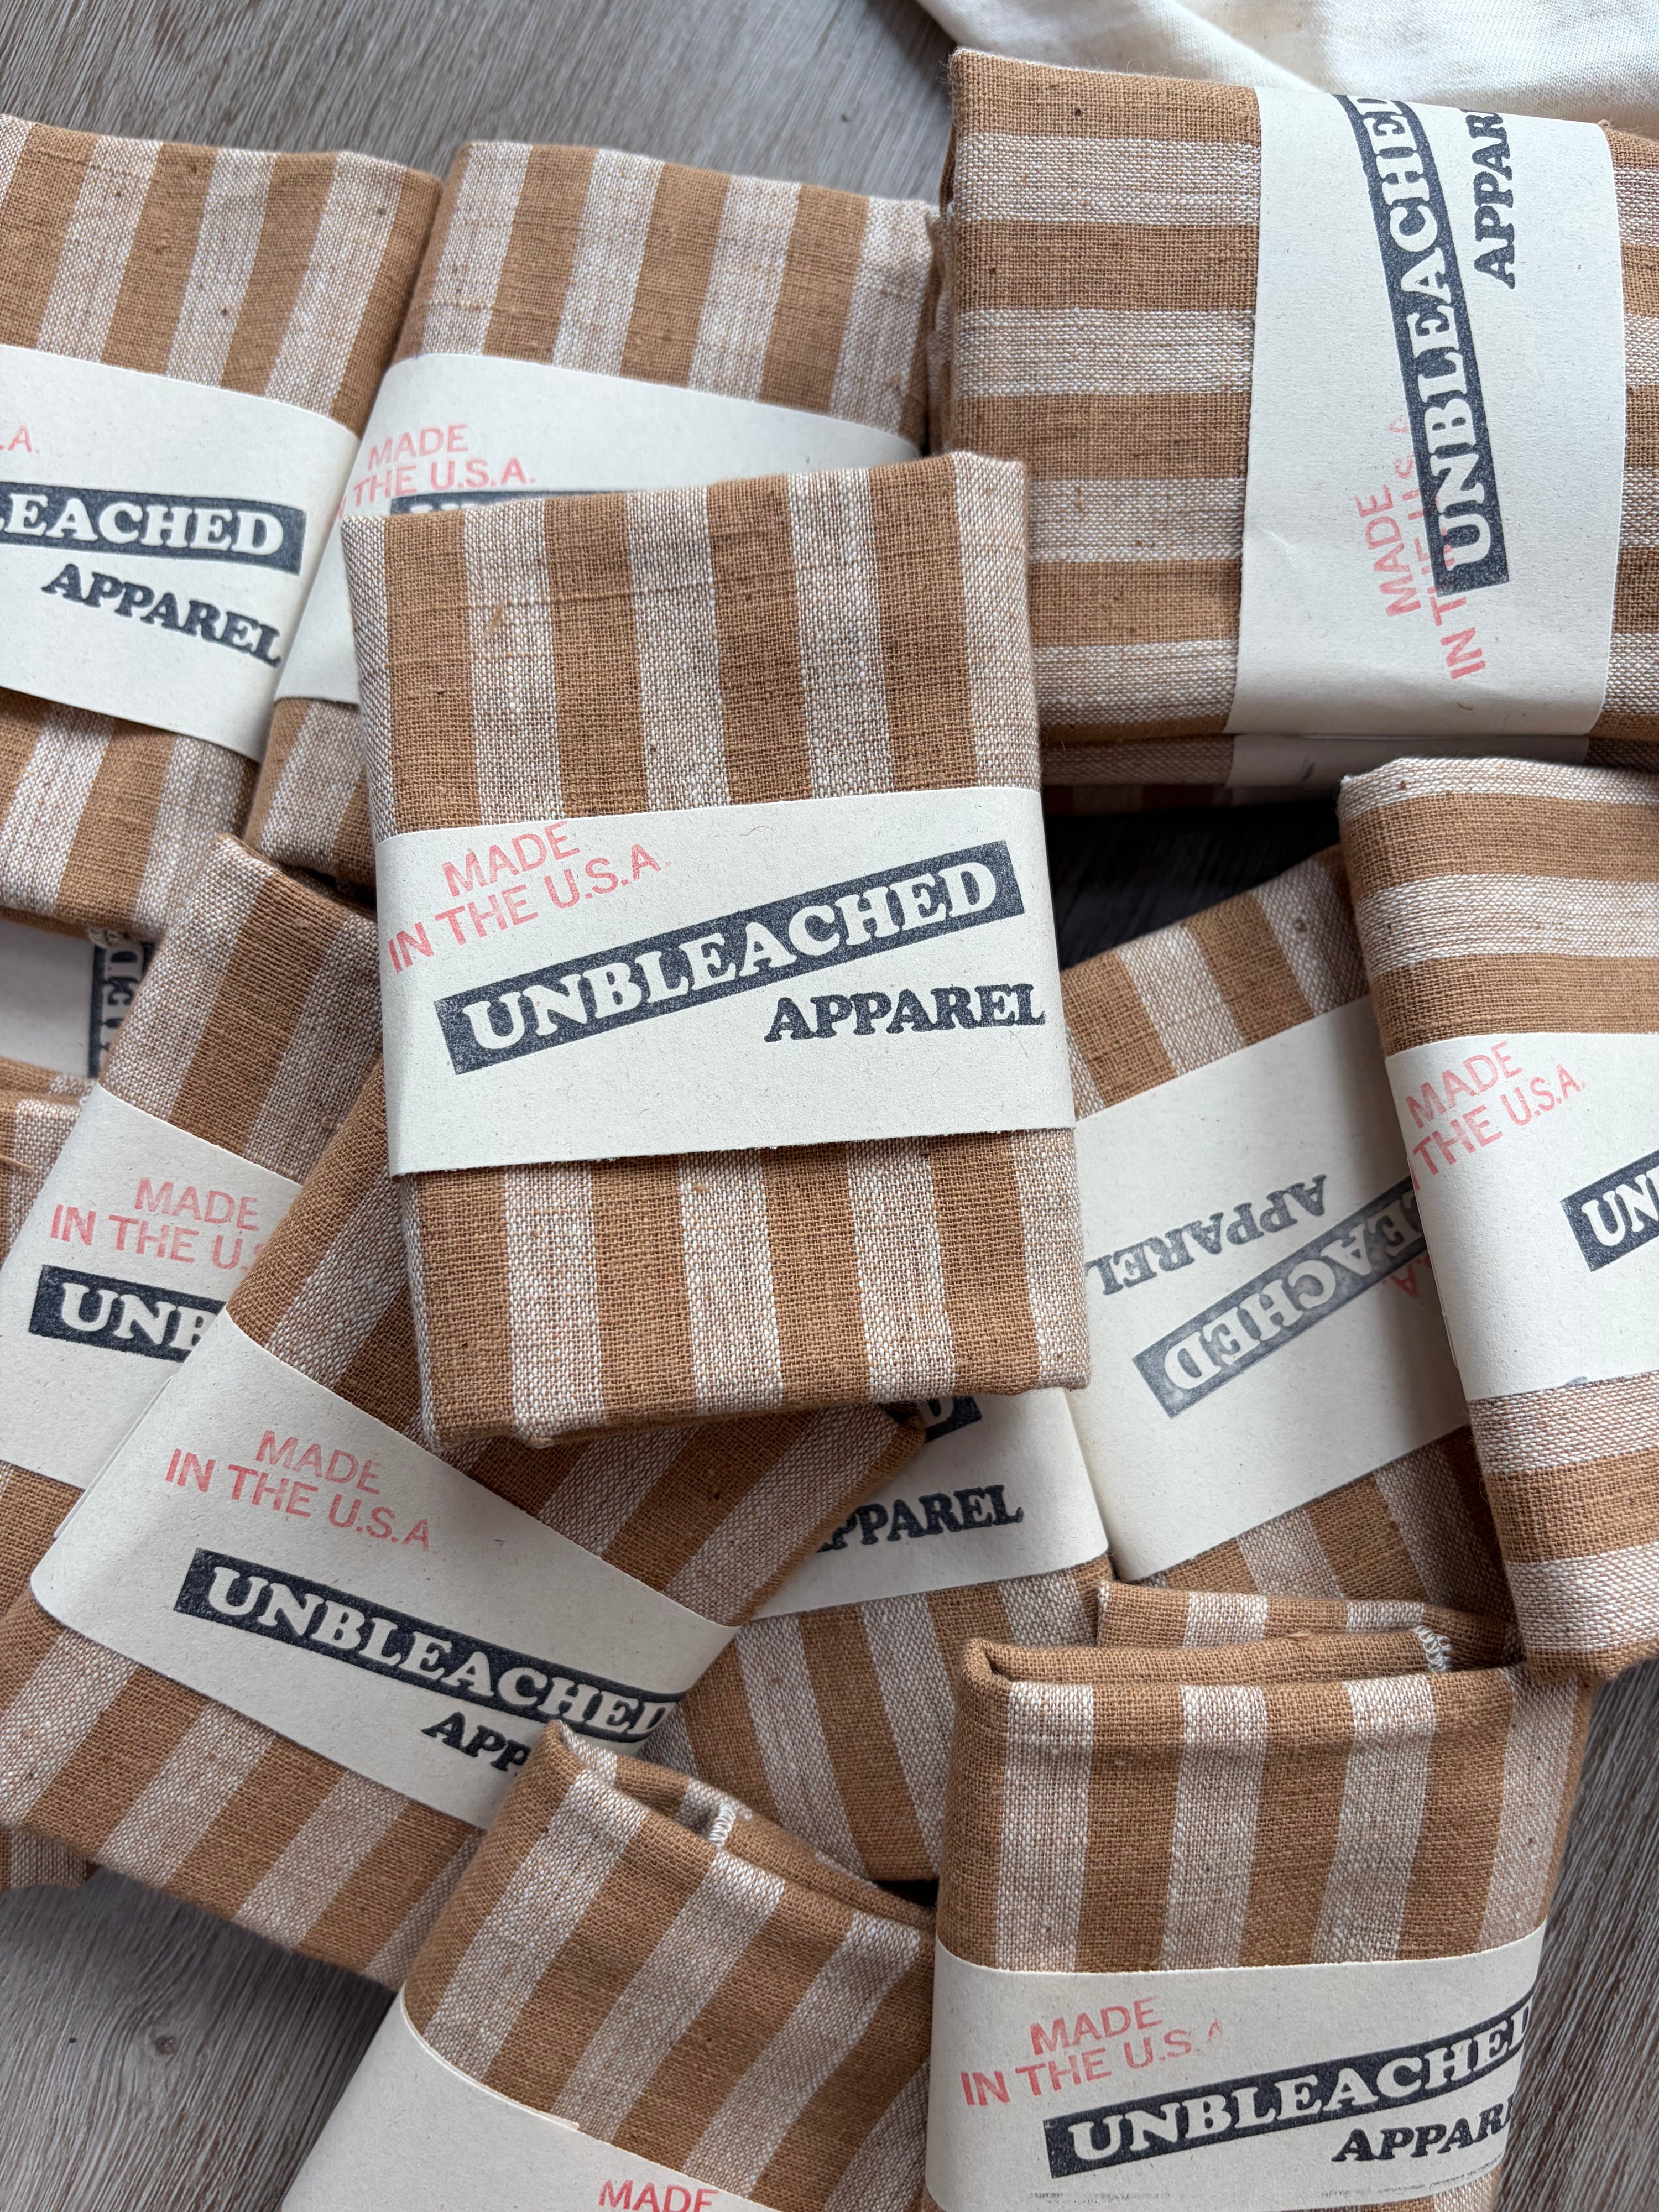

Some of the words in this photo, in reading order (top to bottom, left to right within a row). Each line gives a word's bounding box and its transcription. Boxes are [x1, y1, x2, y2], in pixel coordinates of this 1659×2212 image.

[1346, 95, 1491, 572] UNBLEACHED
[353, 465, 418, 508] THE
[430, 457, 536, 492] U.S.A.
[367, 424, 469, 472] MADE
[0, 491, 284, 556] EACHED
[1355, 484, 1421, 618] MADE
[41, 562, 281, 668] APPAREL
[1440, 627, 1486, 680] IN
[441, 821, 580, 898] MADE
[387, 922, 435, 974] IN
[434, 884, 539, 945] THE
[462, 861, 997, 1050] UNBLEACHED
[764, 983, 1047, 1043] APPAREL
[1405, 1040, 1522, 1129] MADE
[1412, 1104, 1503, 1176] THE
[50, 1204, 97, 1246] IN
[108, 1214, 200, 1264] THE
[212, 1234, 265, 1272] U.
[134, 1177, 260, 1232] MADE
[1085, 1173, 1327, 1295] APPAREL
[1580, 1165, 1659, 1246] UN
[1164, 1191, 1423, 1390] EACHED
[165, 1448, 216, 1493] IN
[227, 1464, 319, 1518] THE
[255, 1430, 381, 1495] MADE
[816, 1484, 1024, 1553] PPAREL
[208, 1566, 678, 1735] UNBLEACHED
[421, 1711, 532, 1772] APP
[1029, 1996, 1163, 2056] MADE
[960, 2070, 1010, 2106] IN
[1014, 2047, 1112, 2096] THE
[1067, 1994, 1533, 2162] UNBLEACHED
[1331, 2094, 1514, 2162] APPAR
[598, 2179, 719, 2212] MADE
